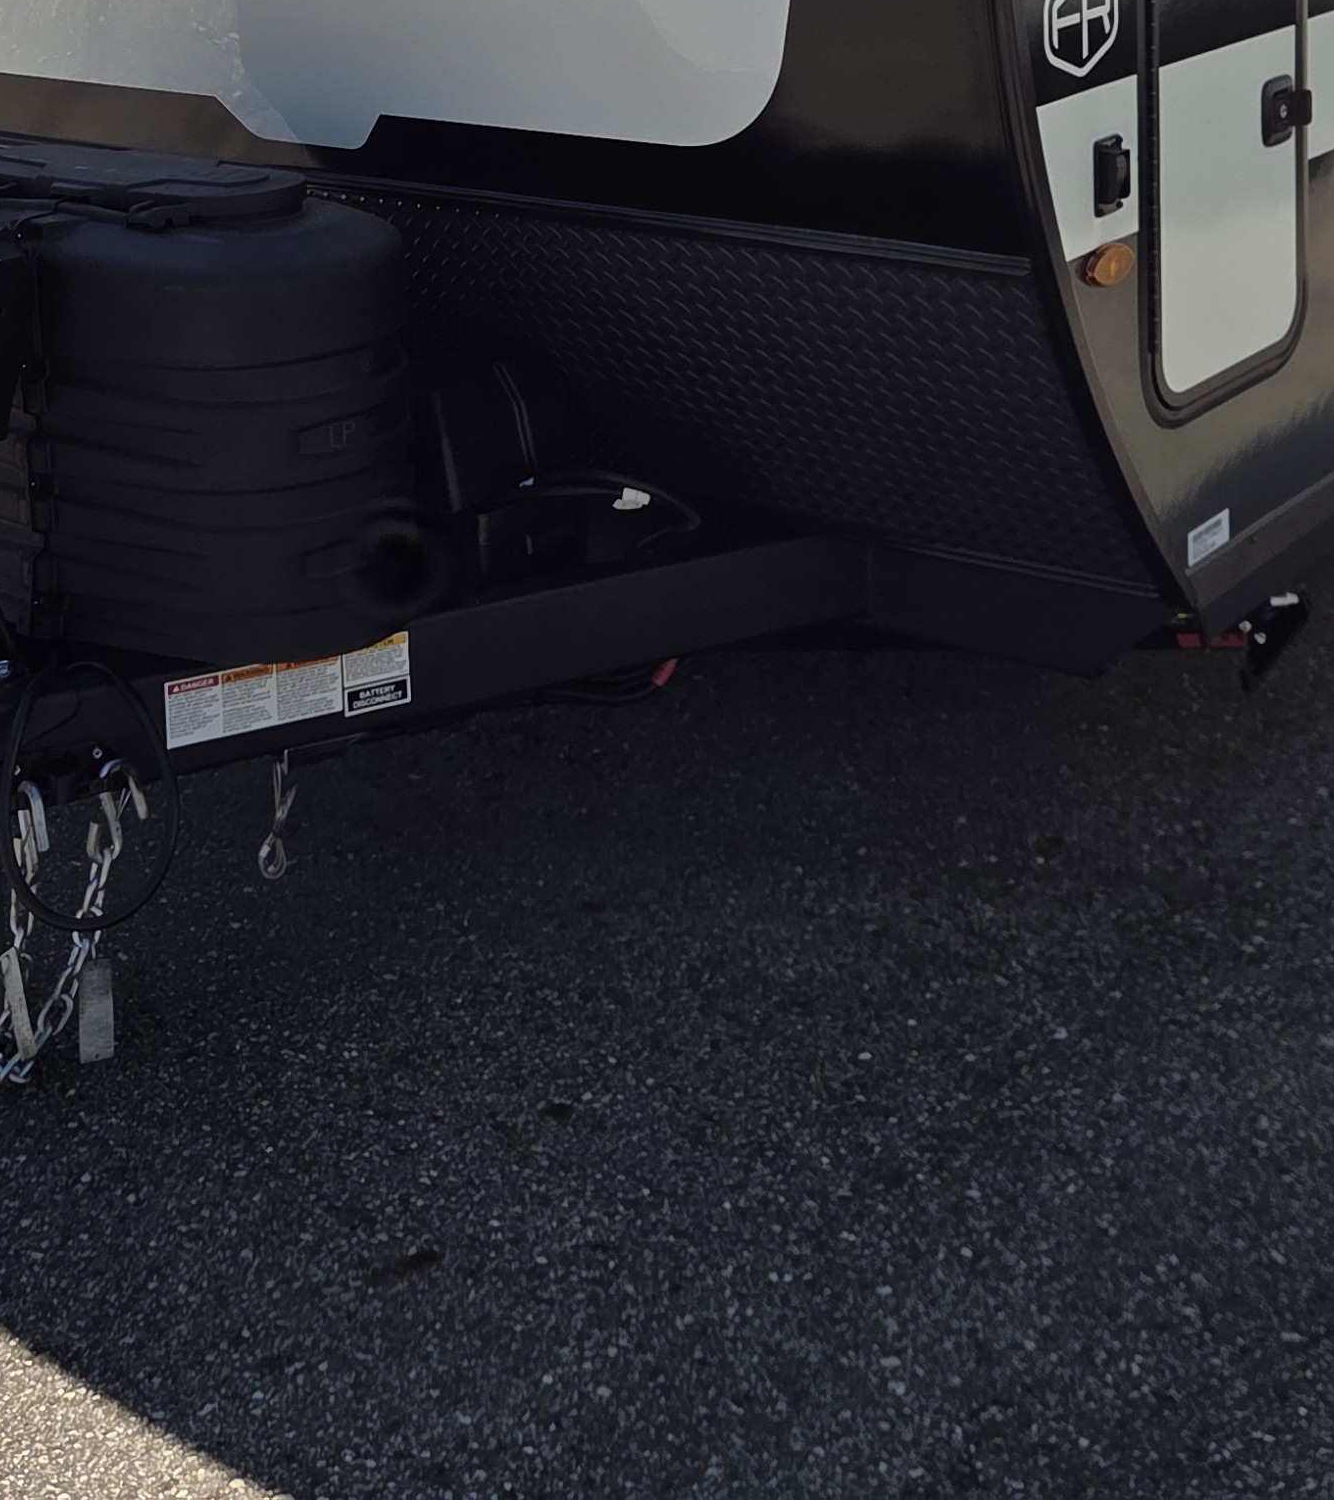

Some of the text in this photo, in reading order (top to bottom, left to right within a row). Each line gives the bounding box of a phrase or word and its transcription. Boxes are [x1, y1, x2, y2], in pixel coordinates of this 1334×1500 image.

[329, 420, 356, 449] LP
[181, 678, 214, 691] DANGER
[359, 684, 395, 699] BATTERY
[352, 691, 402, 709] DISCONNECT
